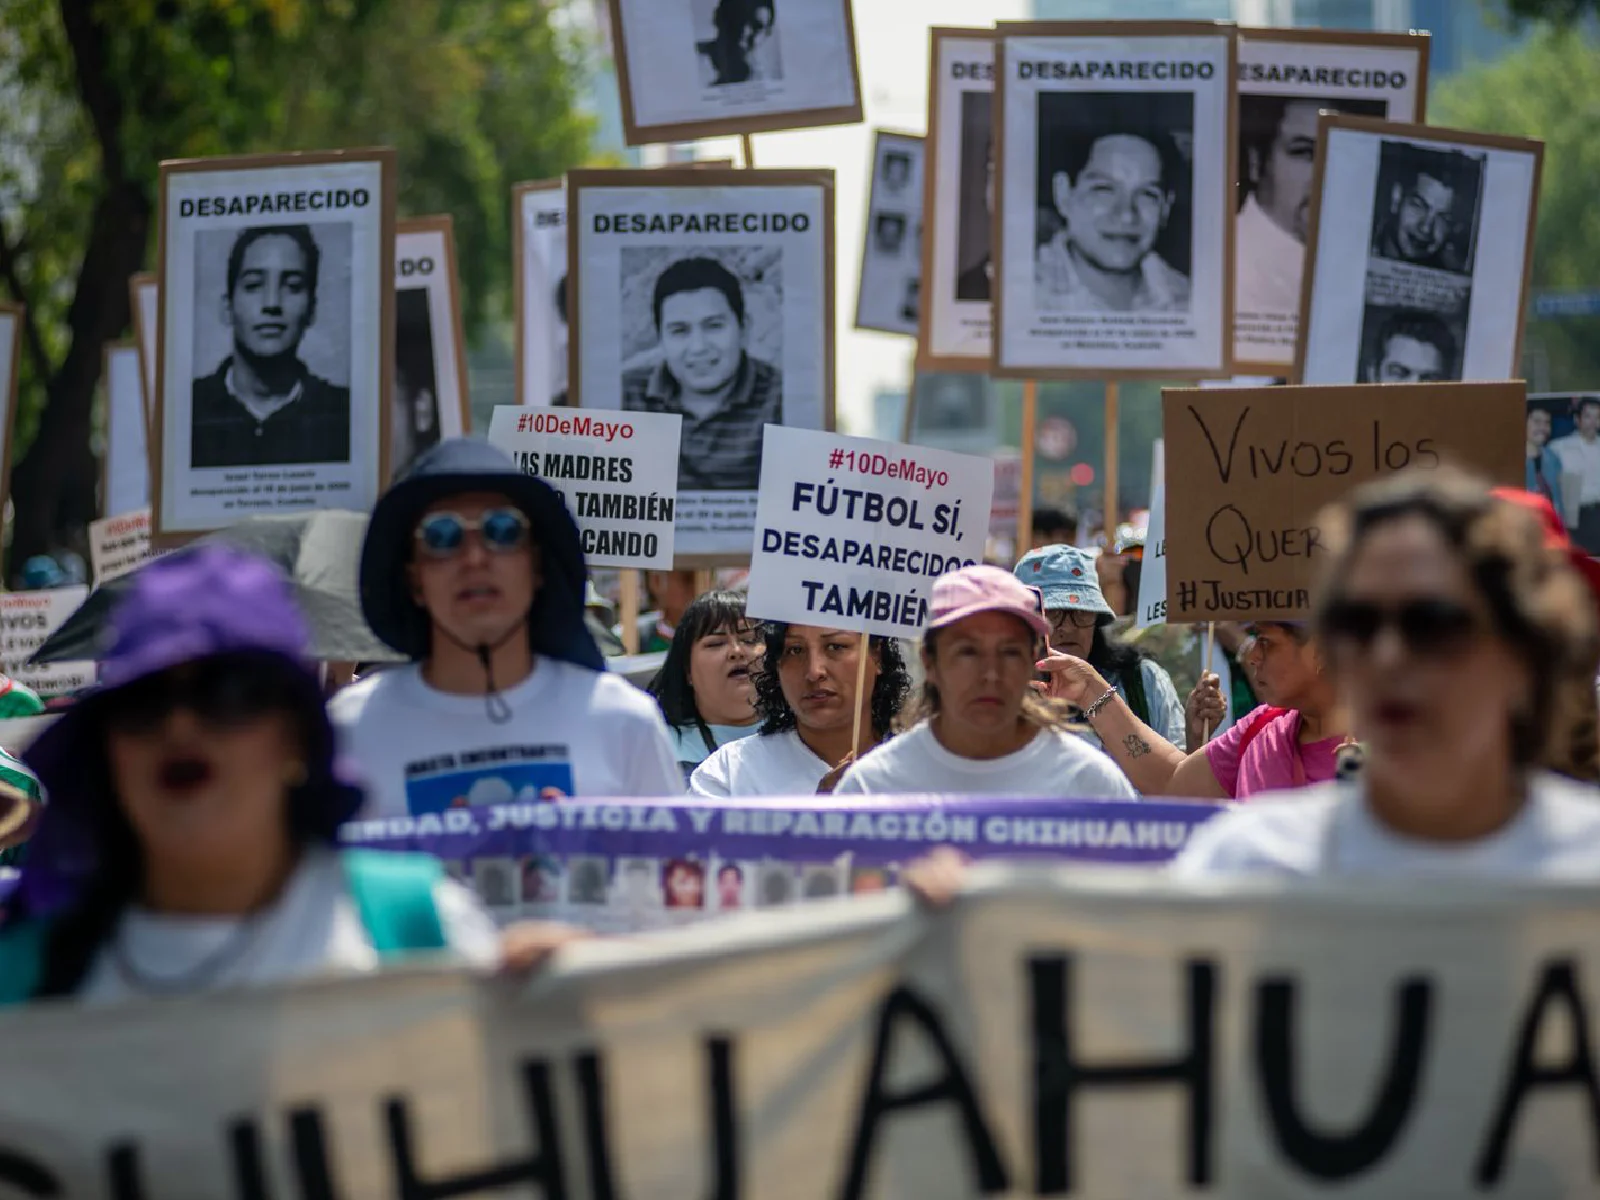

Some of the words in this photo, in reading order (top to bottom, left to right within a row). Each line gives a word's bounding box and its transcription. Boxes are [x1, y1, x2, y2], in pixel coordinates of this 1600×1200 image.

[1017, 60, 1214, 80] DESAPARECIDO
[180, 188, 370, 218] DESAPARECIDO
[592, 212, 810, 233] DESAPARECIDO
[517, 413, 634, 441] #10DeMayo
[543, 453, 633, 483] MADRES
[829, 449, 949, 489] #10DeMayo
[575, 492, 674, 522] TAMBIÉN
[792, 478, 924, 531] FÚTBOL
[932, 499, 964, 541] SÍ,
[580, 528, 658, 558] CANDO
[338, 808, 479, 843] ERDAD,
[488, 804, 676, 832] JUSTICIA
[688, 811, 715, 832] Y
[722, 808, 975, 843] REPARACIÓN
